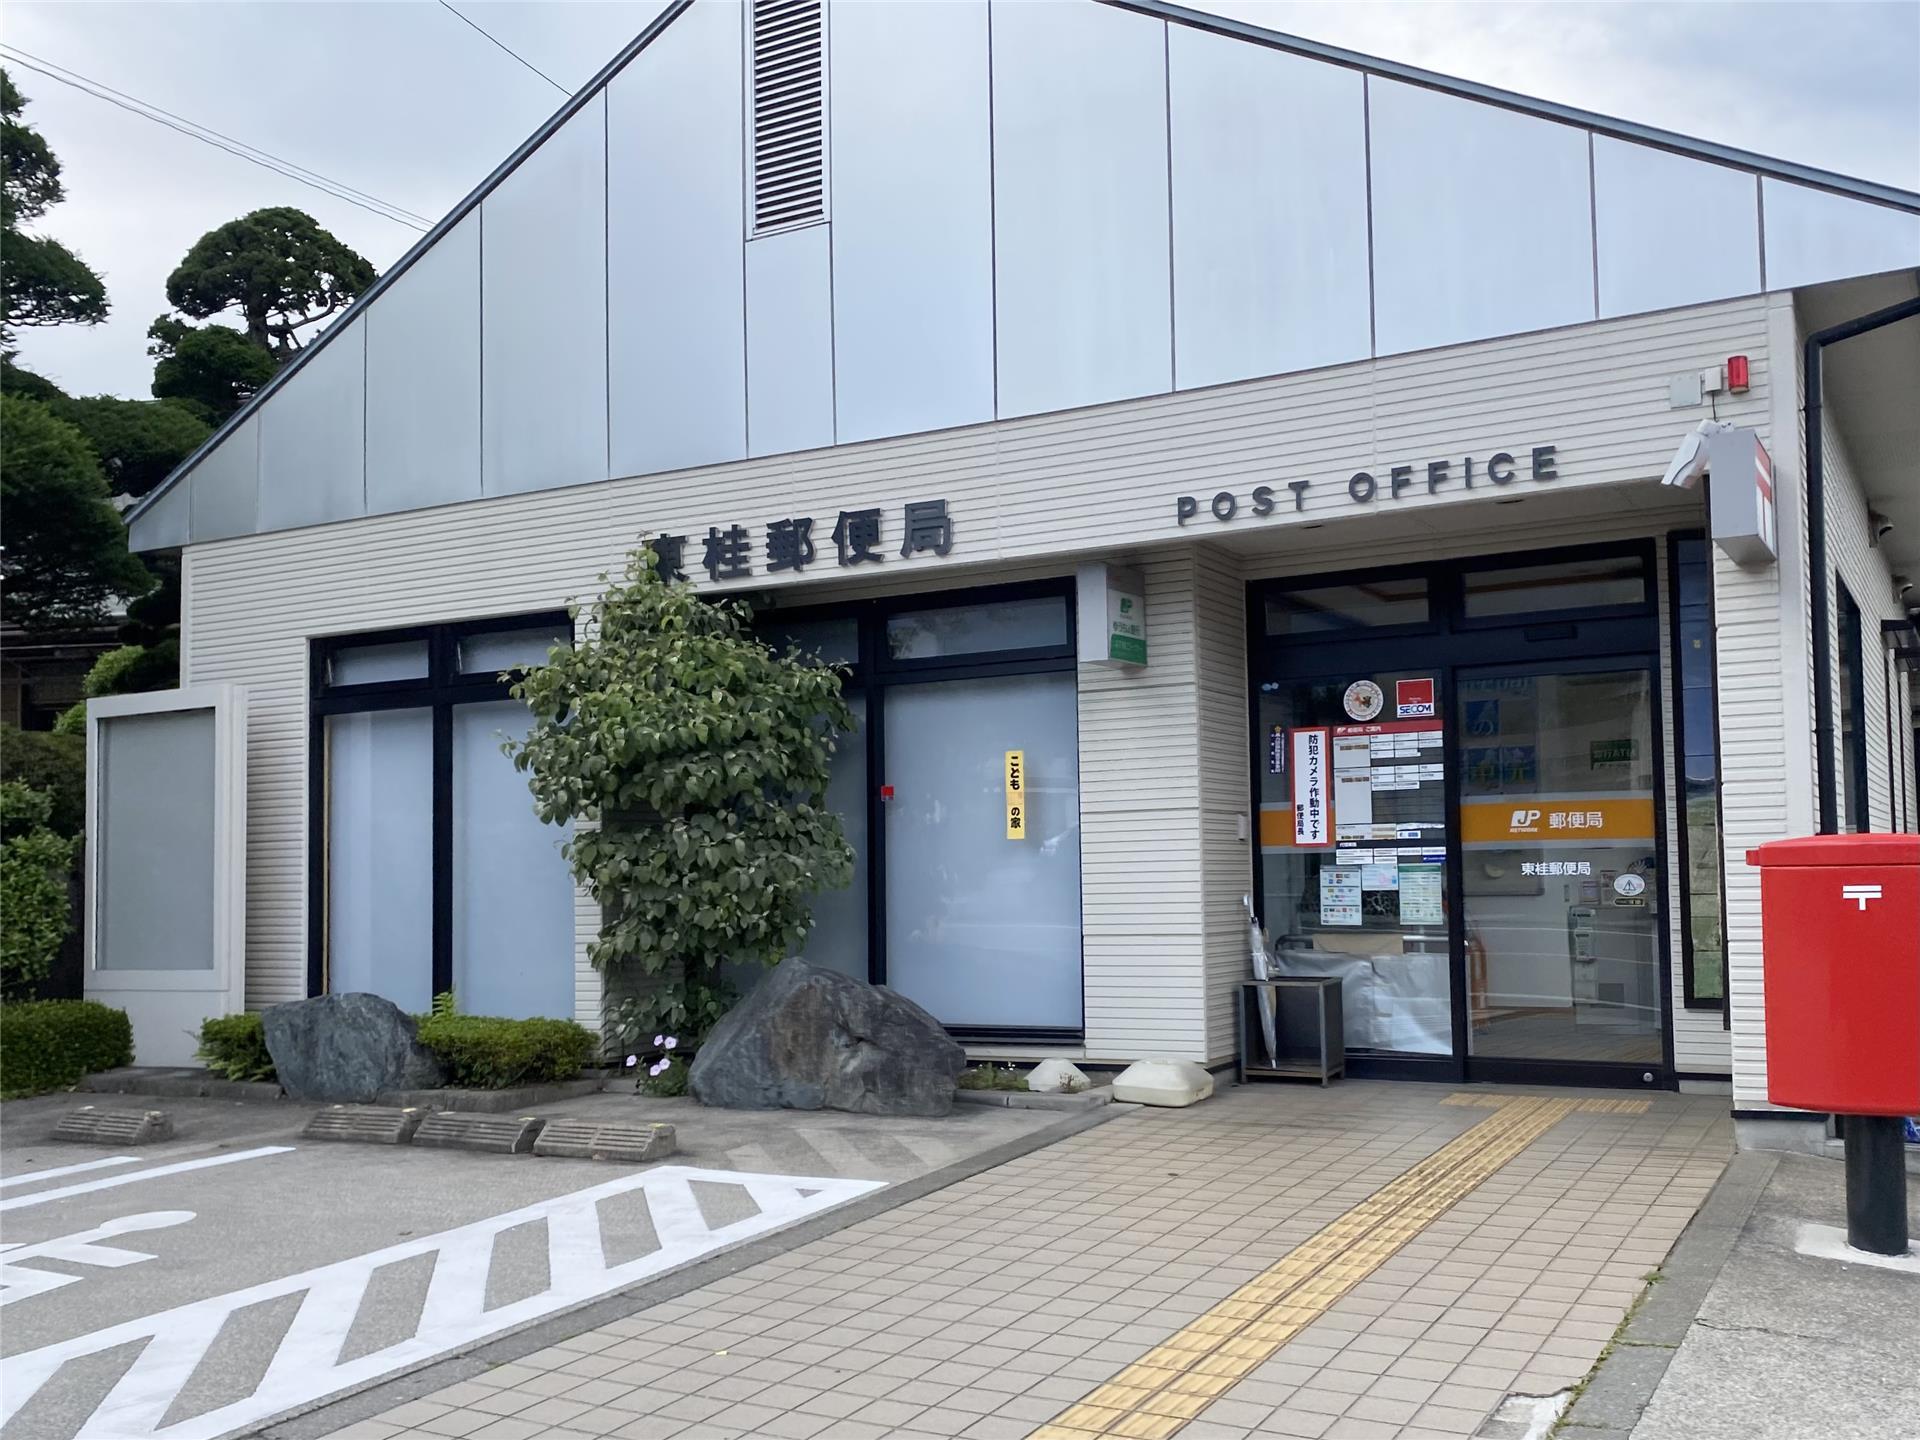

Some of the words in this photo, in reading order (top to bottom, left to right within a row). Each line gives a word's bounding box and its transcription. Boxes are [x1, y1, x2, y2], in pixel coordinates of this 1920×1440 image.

[1177, 480, 1310, 526] POST
[1348, 444, 1558, 503] OFFICE
[1399, 704, 1432, 714] SECOM
[1308, 734, 1320, 840] 防犯カメラ作動中です
[1296, 804, 1305, 836] 郵便局長
[1549, 811, 1603, 829] 郵便局
[1521, 861, 1591, 876] 東桂郵便局
